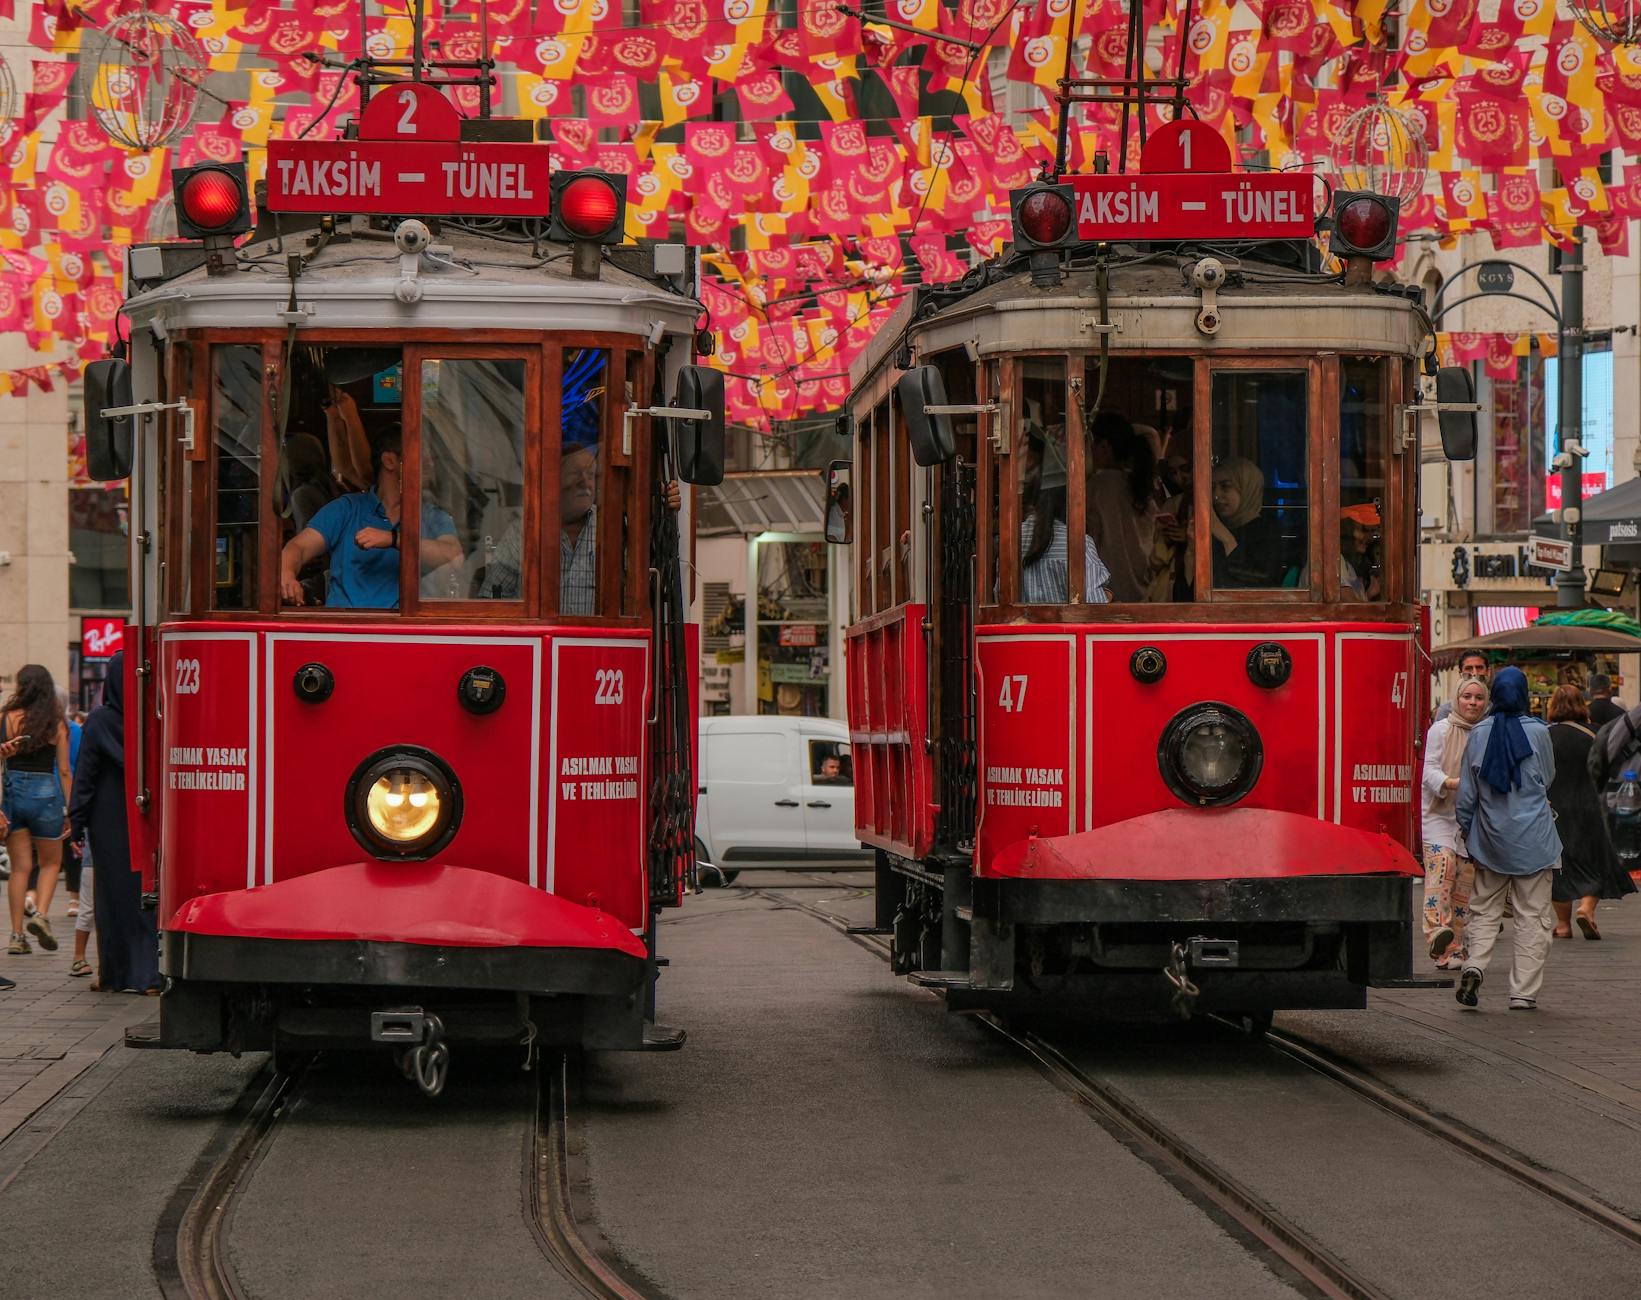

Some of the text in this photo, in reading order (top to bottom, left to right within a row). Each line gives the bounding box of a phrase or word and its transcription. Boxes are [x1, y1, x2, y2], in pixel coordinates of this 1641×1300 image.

[674, 3, 697, 27] 25
[37, 66, 55, 83] 25
[602, 87, 623, 106] 25
[397, 89, 418, 134] 2
[1477, 111, 1497, 132] 25
[208, 137, 227, 155] 25
[1178, 129, 1192, 169] 1
[277, 151, 381, 196] TAKSİM
[441, 152, 533, 199] TÜNEL
[605, 159, 625, 174] 25
[735, 158, 753, 176] 25
[831, 190, 848, 212] 25
[1075, 182, 1159, 223] AKSİM
[1222, 183, 1305, 224] TÜNEL
[1479, 273, 1514, 283] KGYS
[1609, 520, 1638, 541] patsosis
[175, 658, 200, 694] 223
[595, 669, 624, 705] 223
[999, 674, 1029, 713] 47
[1391, 671, 1408, 709] 47
[169, 747, 247, 766] ASILMAK YASAK
[561, 756, 638, 776] ASILMAK YASAK
[178, 769, 245, 791] TEHLİKELİDİR
[987, 766, 1064, 785] ASILMAK YASAK
[1353, 763, 1397, 781] ASILMAK
[561, 778, 638, 801] VE TEHLİKELİDİR
[996, 787, 1062, 808] TEHLİKELİDİR
[1352, 786, 1367, 803] VE
